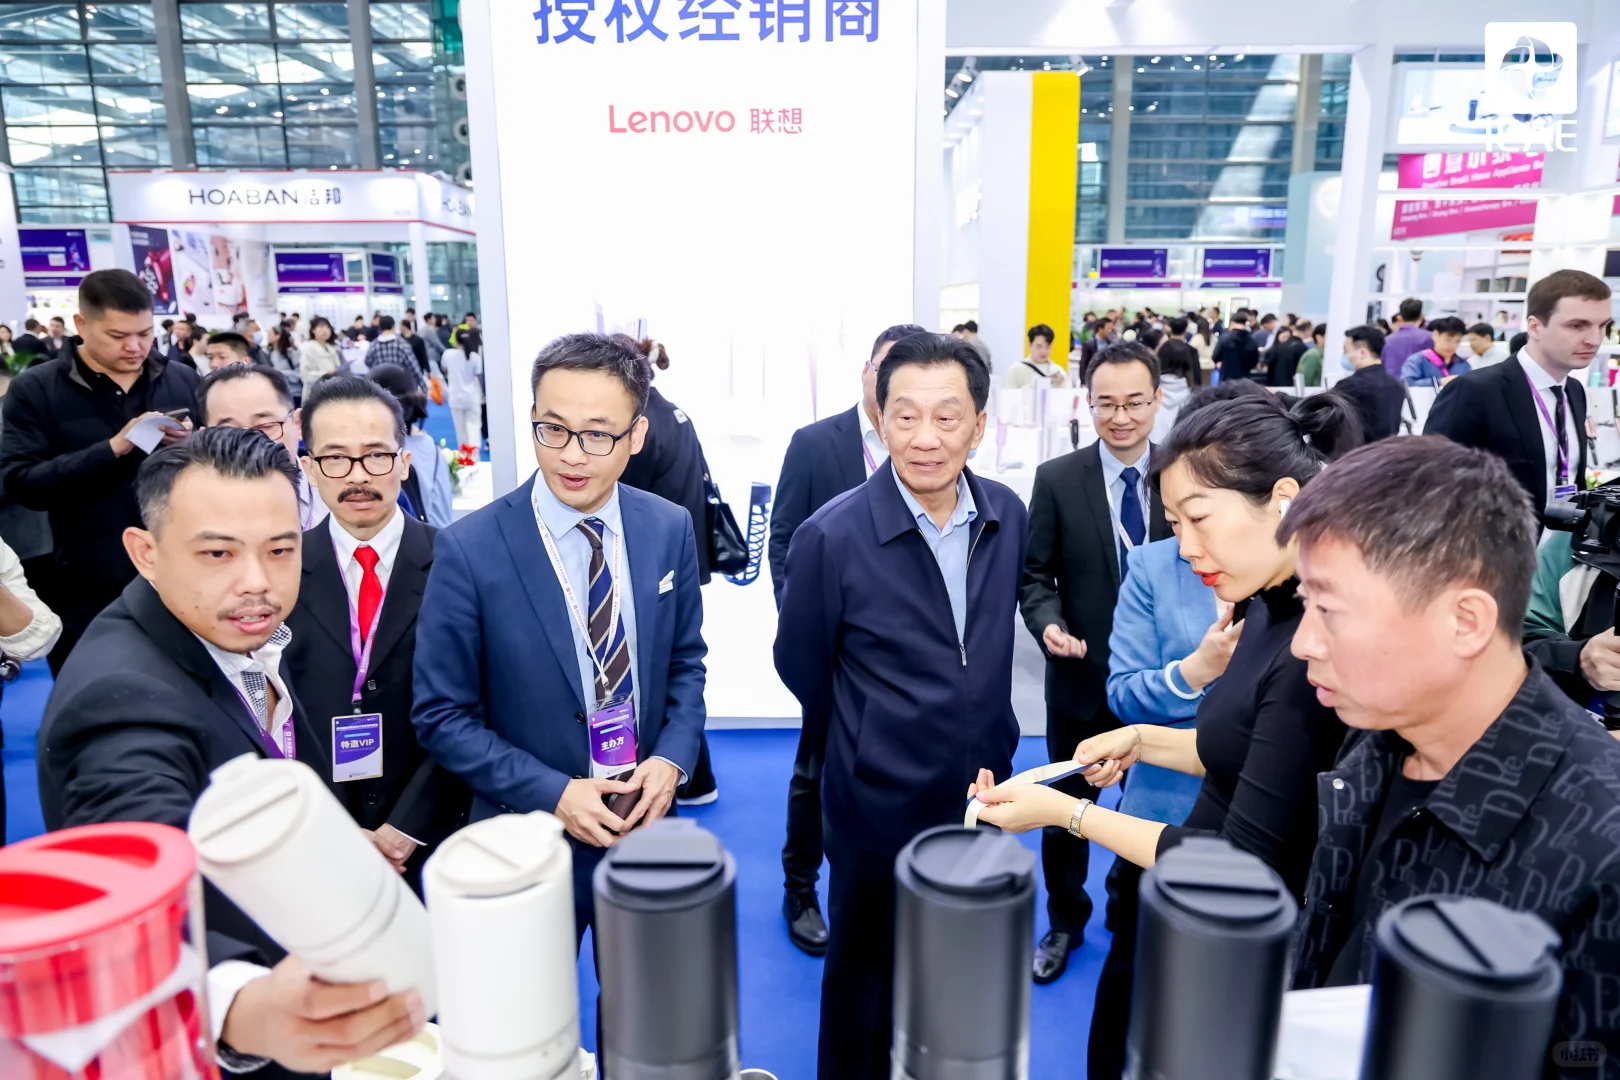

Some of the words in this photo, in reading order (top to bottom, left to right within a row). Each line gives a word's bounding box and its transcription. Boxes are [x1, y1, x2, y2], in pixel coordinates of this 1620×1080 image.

[533, 0, 880, 44] 授权经销商
[609, 105, 736, 133] Lenovo
[750, 108, 803, 134] 联想
[189, 189, 298, 205] HOABAN
[601, 736, 625, 751] 主办方
